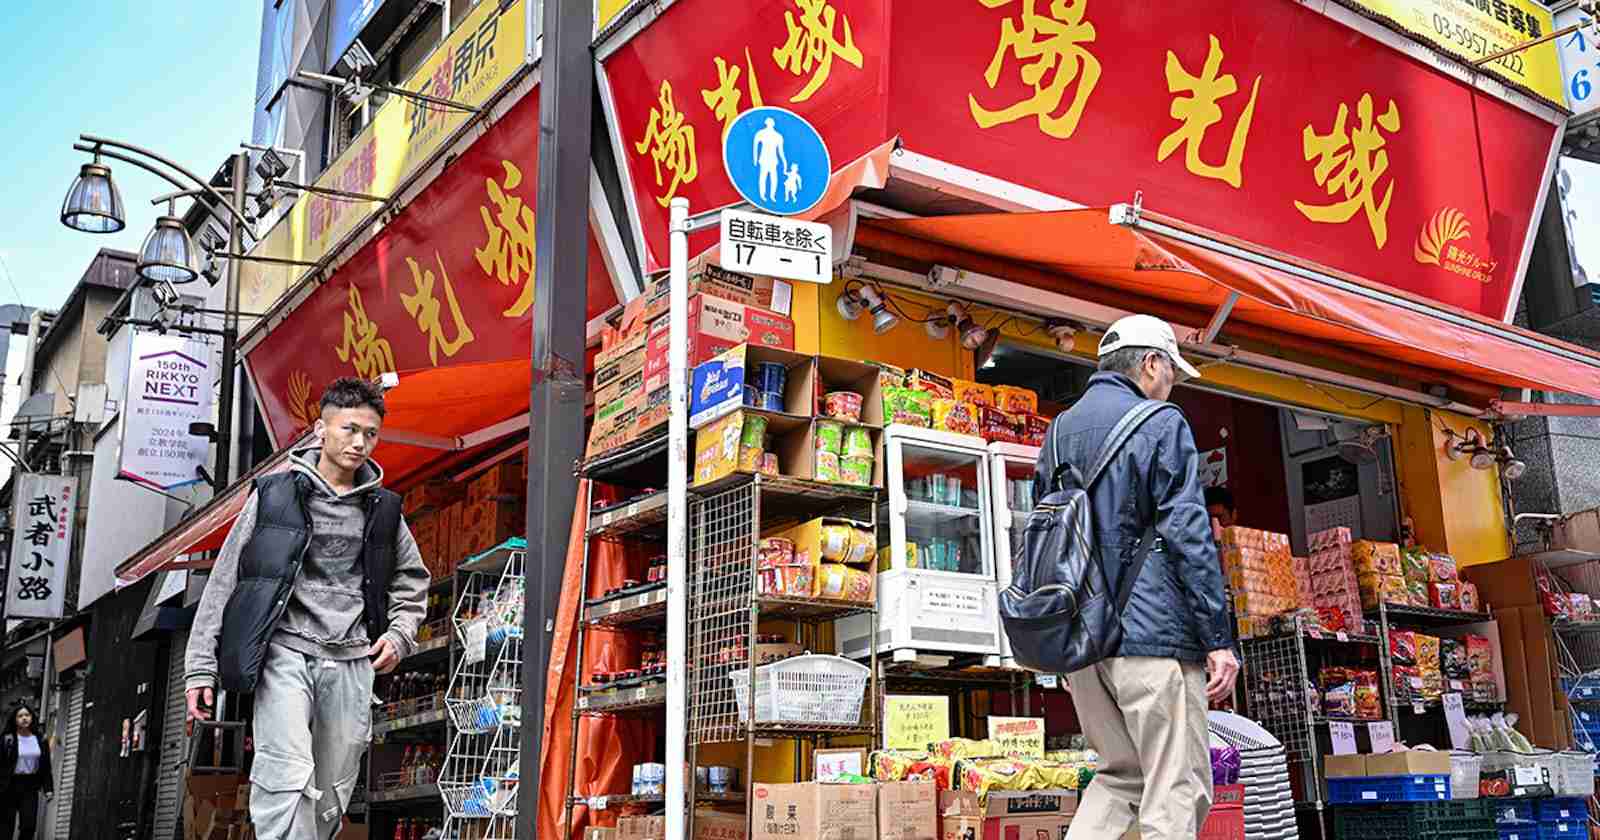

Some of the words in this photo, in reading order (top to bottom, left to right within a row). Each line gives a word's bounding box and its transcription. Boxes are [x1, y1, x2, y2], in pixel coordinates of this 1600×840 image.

[729, 217, 826, 251] 自転車を除く
[736, 243, 756, 266] 17
[157, 360, 190, 372] 150th
[146, 370, 199, 385] RIKKYO
[145, 381, 199, 398] NEXT
[17, 494, 58, 601] 武者小路
